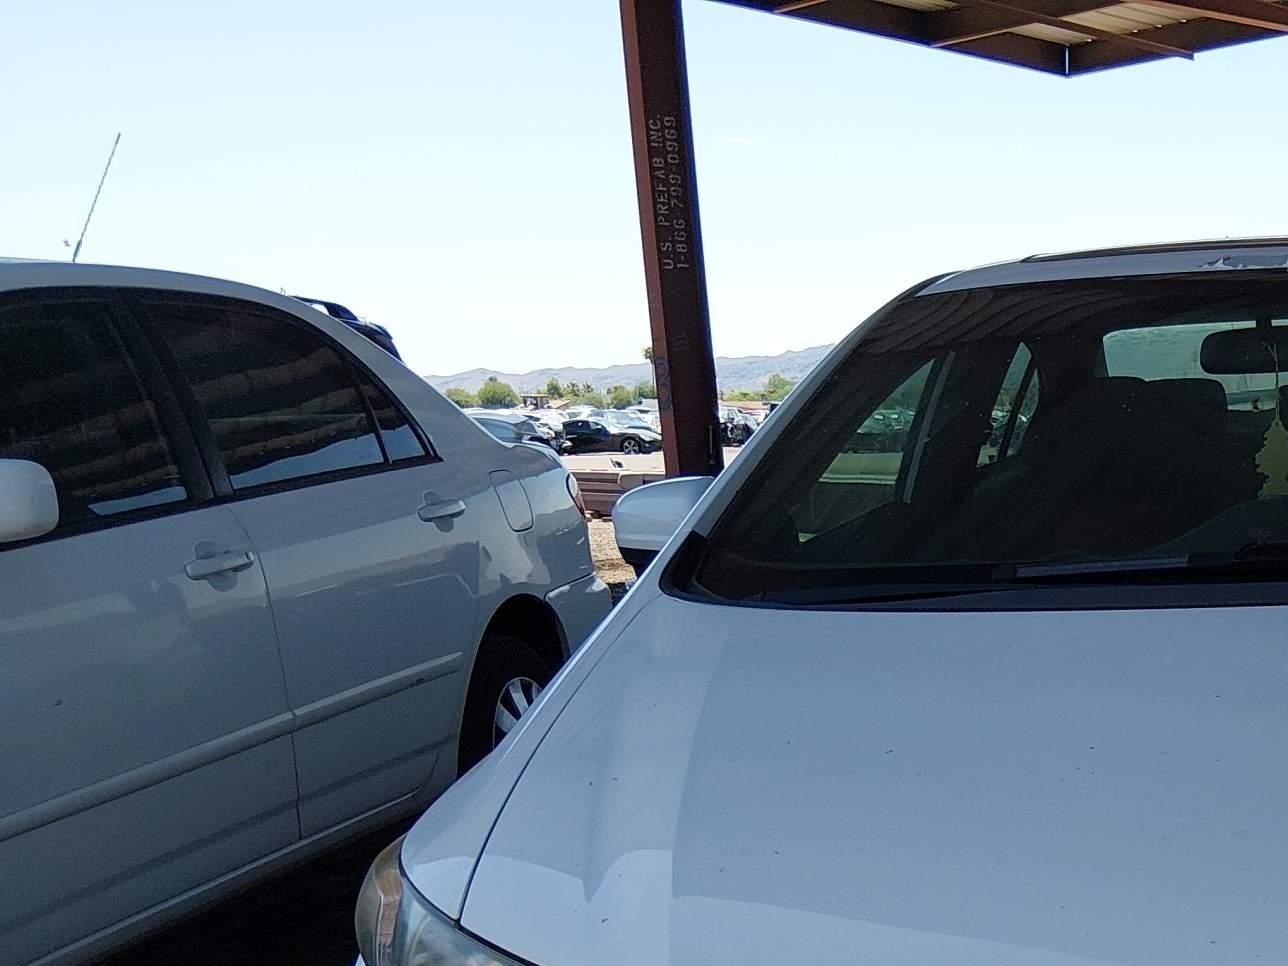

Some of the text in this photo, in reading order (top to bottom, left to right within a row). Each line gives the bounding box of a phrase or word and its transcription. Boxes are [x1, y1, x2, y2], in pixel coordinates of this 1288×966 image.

[648, 113, 675, 270] U.S. PREFAB INC.
